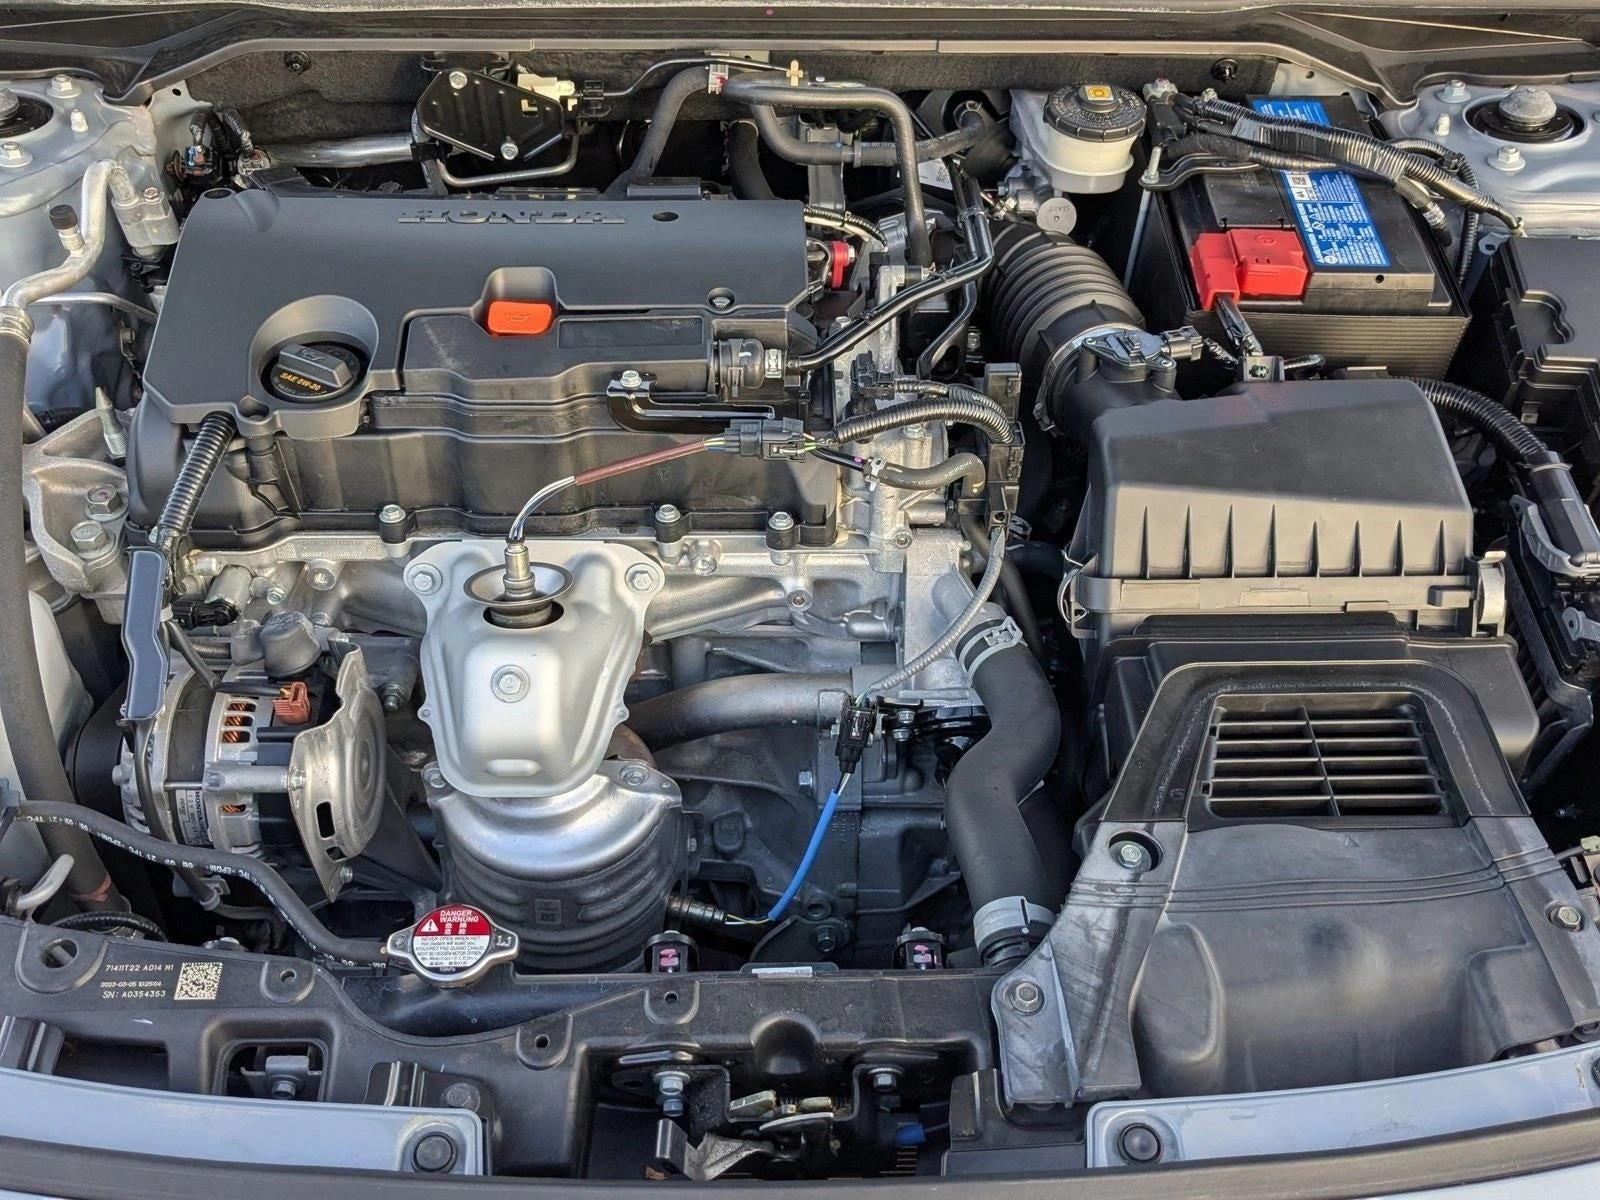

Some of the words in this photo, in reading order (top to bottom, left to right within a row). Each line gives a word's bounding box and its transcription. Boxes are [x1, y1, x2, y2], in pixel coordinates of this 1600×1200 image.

[398, 209, 626, 224] HONDA
[280, 372, 298, 382] SAE
[296, 379, 322, 391] 0W-20
[105, 964, 141, 972] 71411T22
[102, 990, 119, 999] SN:
[121, 990, 166, 998] A0354353
